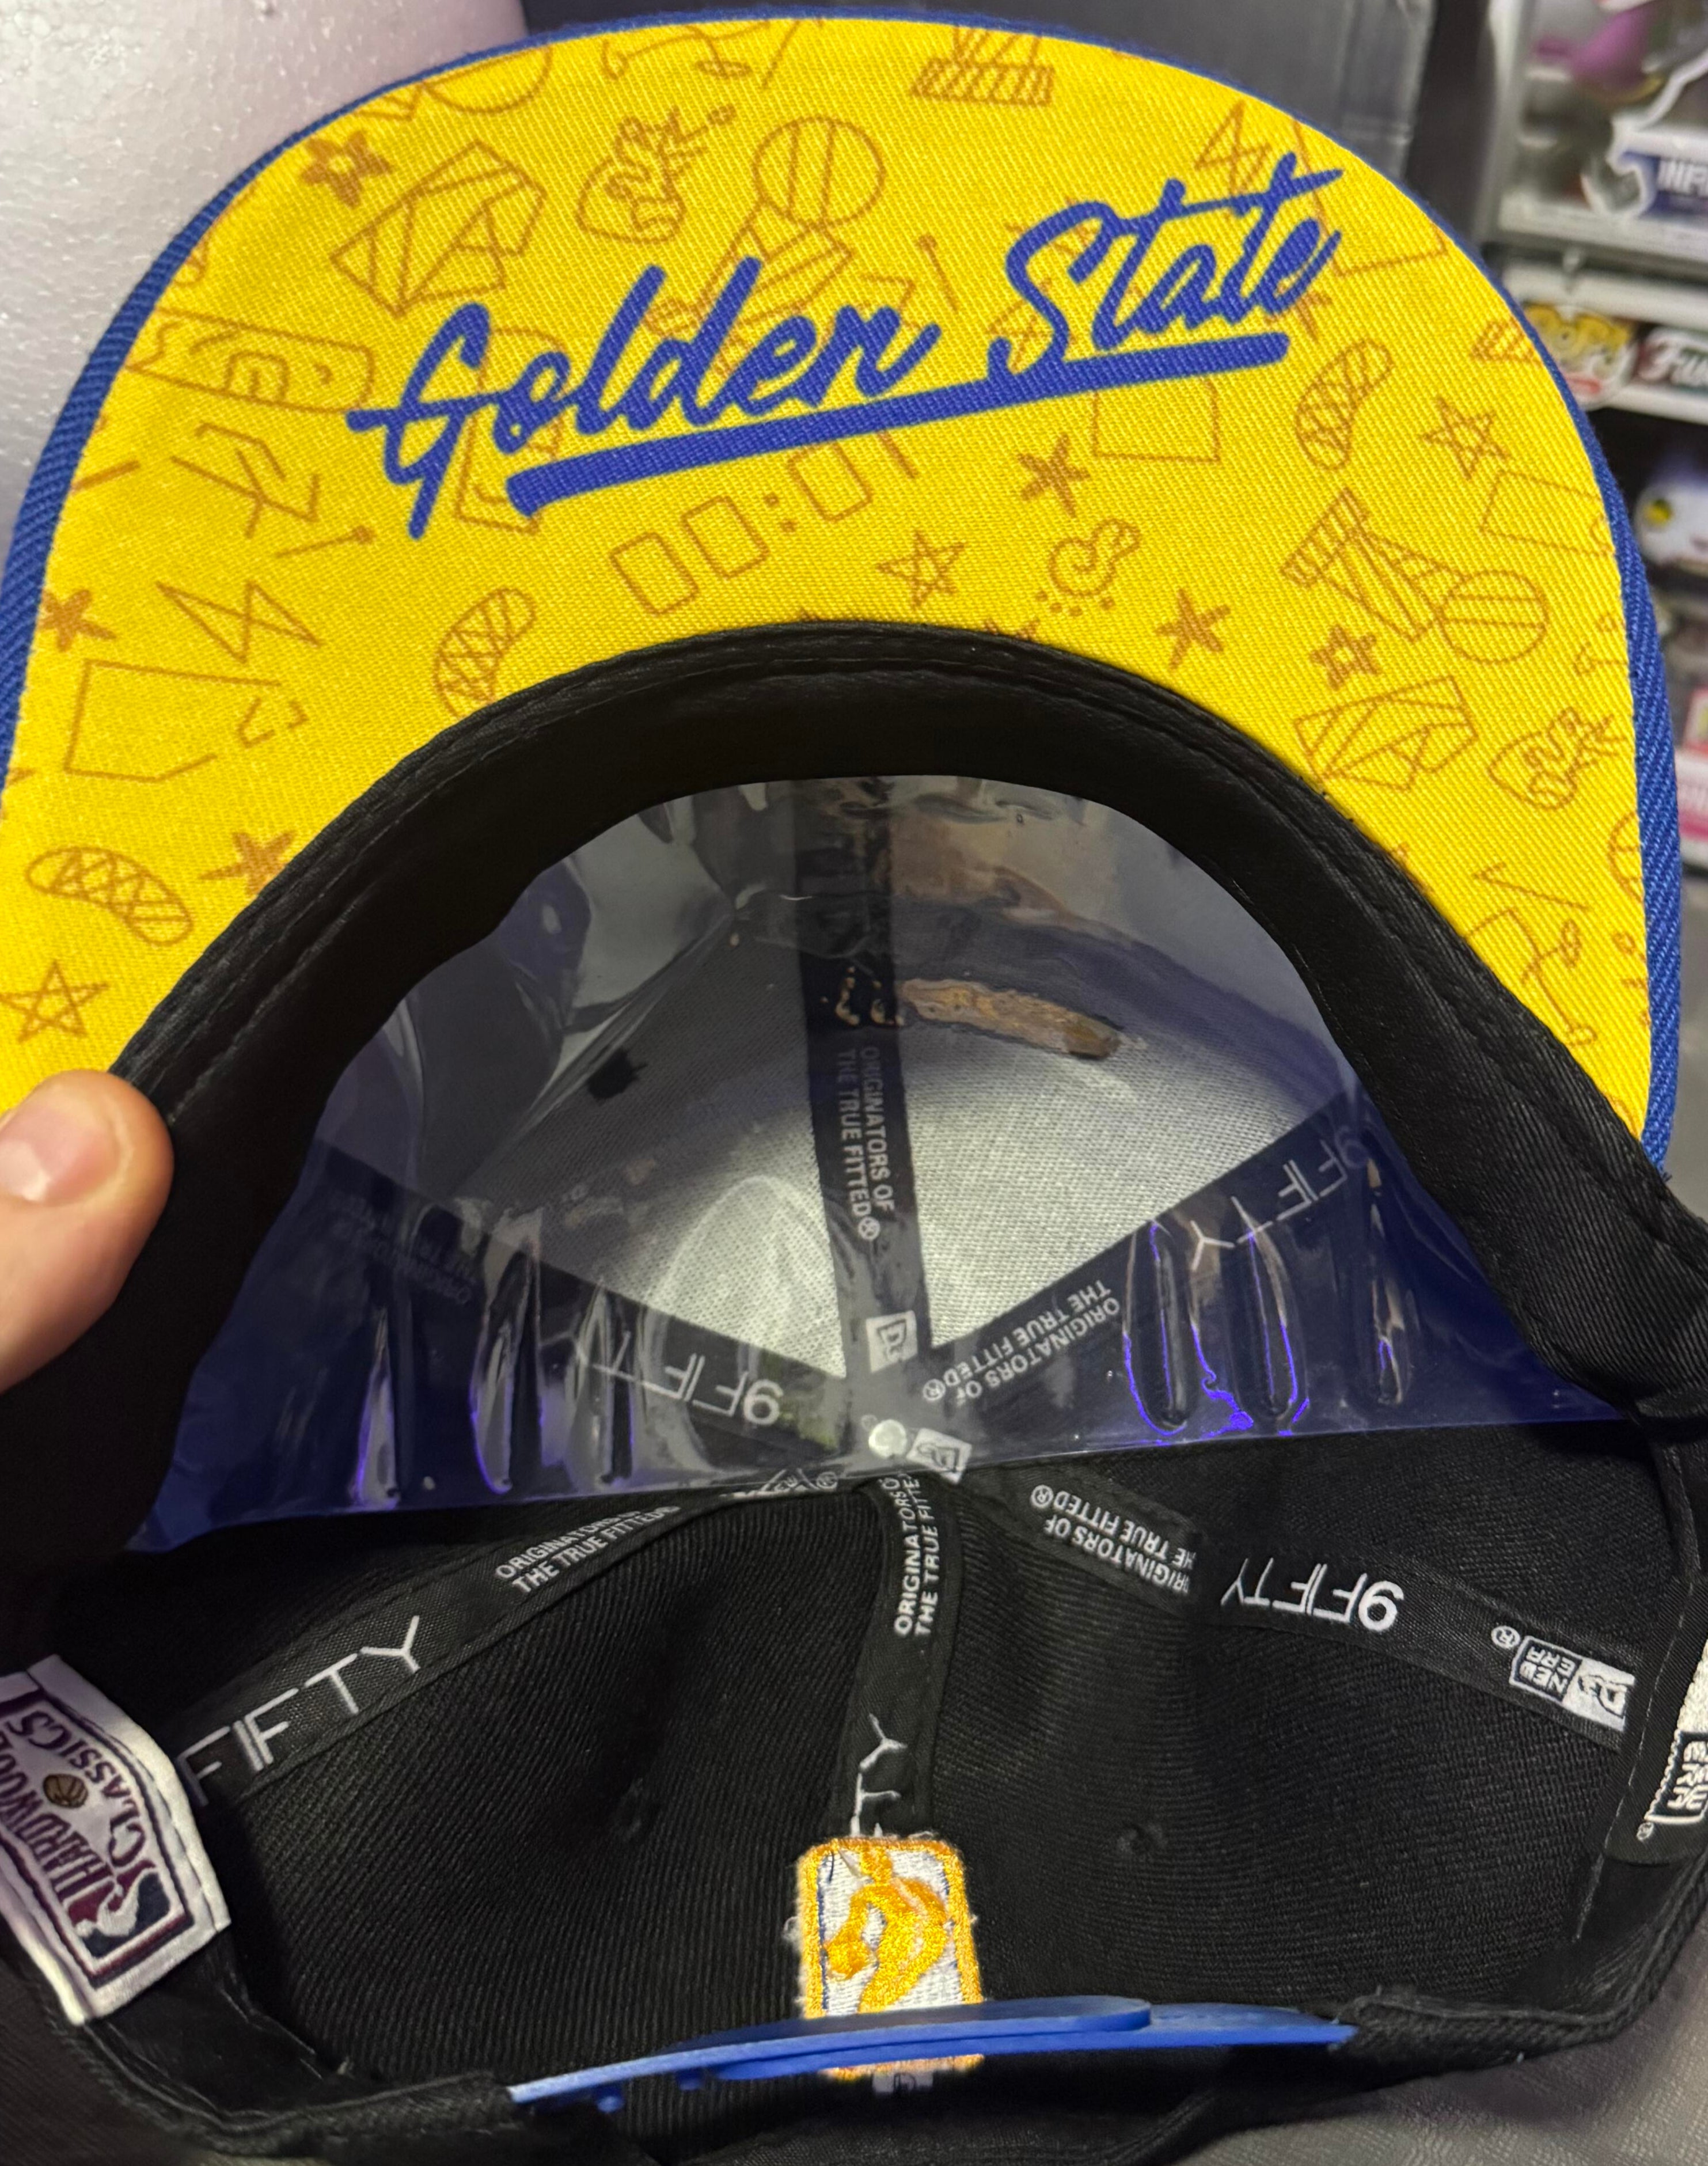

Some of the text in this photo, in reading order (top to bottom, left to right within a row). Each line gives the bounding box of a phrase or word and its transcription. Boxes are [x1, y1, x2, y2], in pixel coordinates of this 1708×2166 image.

[346, 151, 1345, 539] Golden State
[840, 1088, 863, 1140] TRUE
[860, 1045, 895, 1212] ORIGINATORS OF
[1066, 1279, 1112, 1314] THE
[956, 1296, 1120, 1408] ORIGINATORS OF
[1012, 1308, 1071, 1348] TRUE
[921, 1524, 940, 1584] TRUE
[1043, 1513, 1072, 1538] OF
[1119, 1519, 1169, 1561] TRUE
[511, 1561, 560, 1593] THE
[551, 1535, 609, 1568] TRUE
[890, 1490, 921, 1637] ORIGINATORS
[914, 1591, 939, 1636] THE
[1220, 1557, 1405, 1632] 9FIFTY
[1525, 1645, 1577, 1678] ERA
[176, 1615, 421, 1806] FIFTY
[0, 1732, 115, 1902] HARDWO
[5, 1709, 146, 1868] CLASSICS
